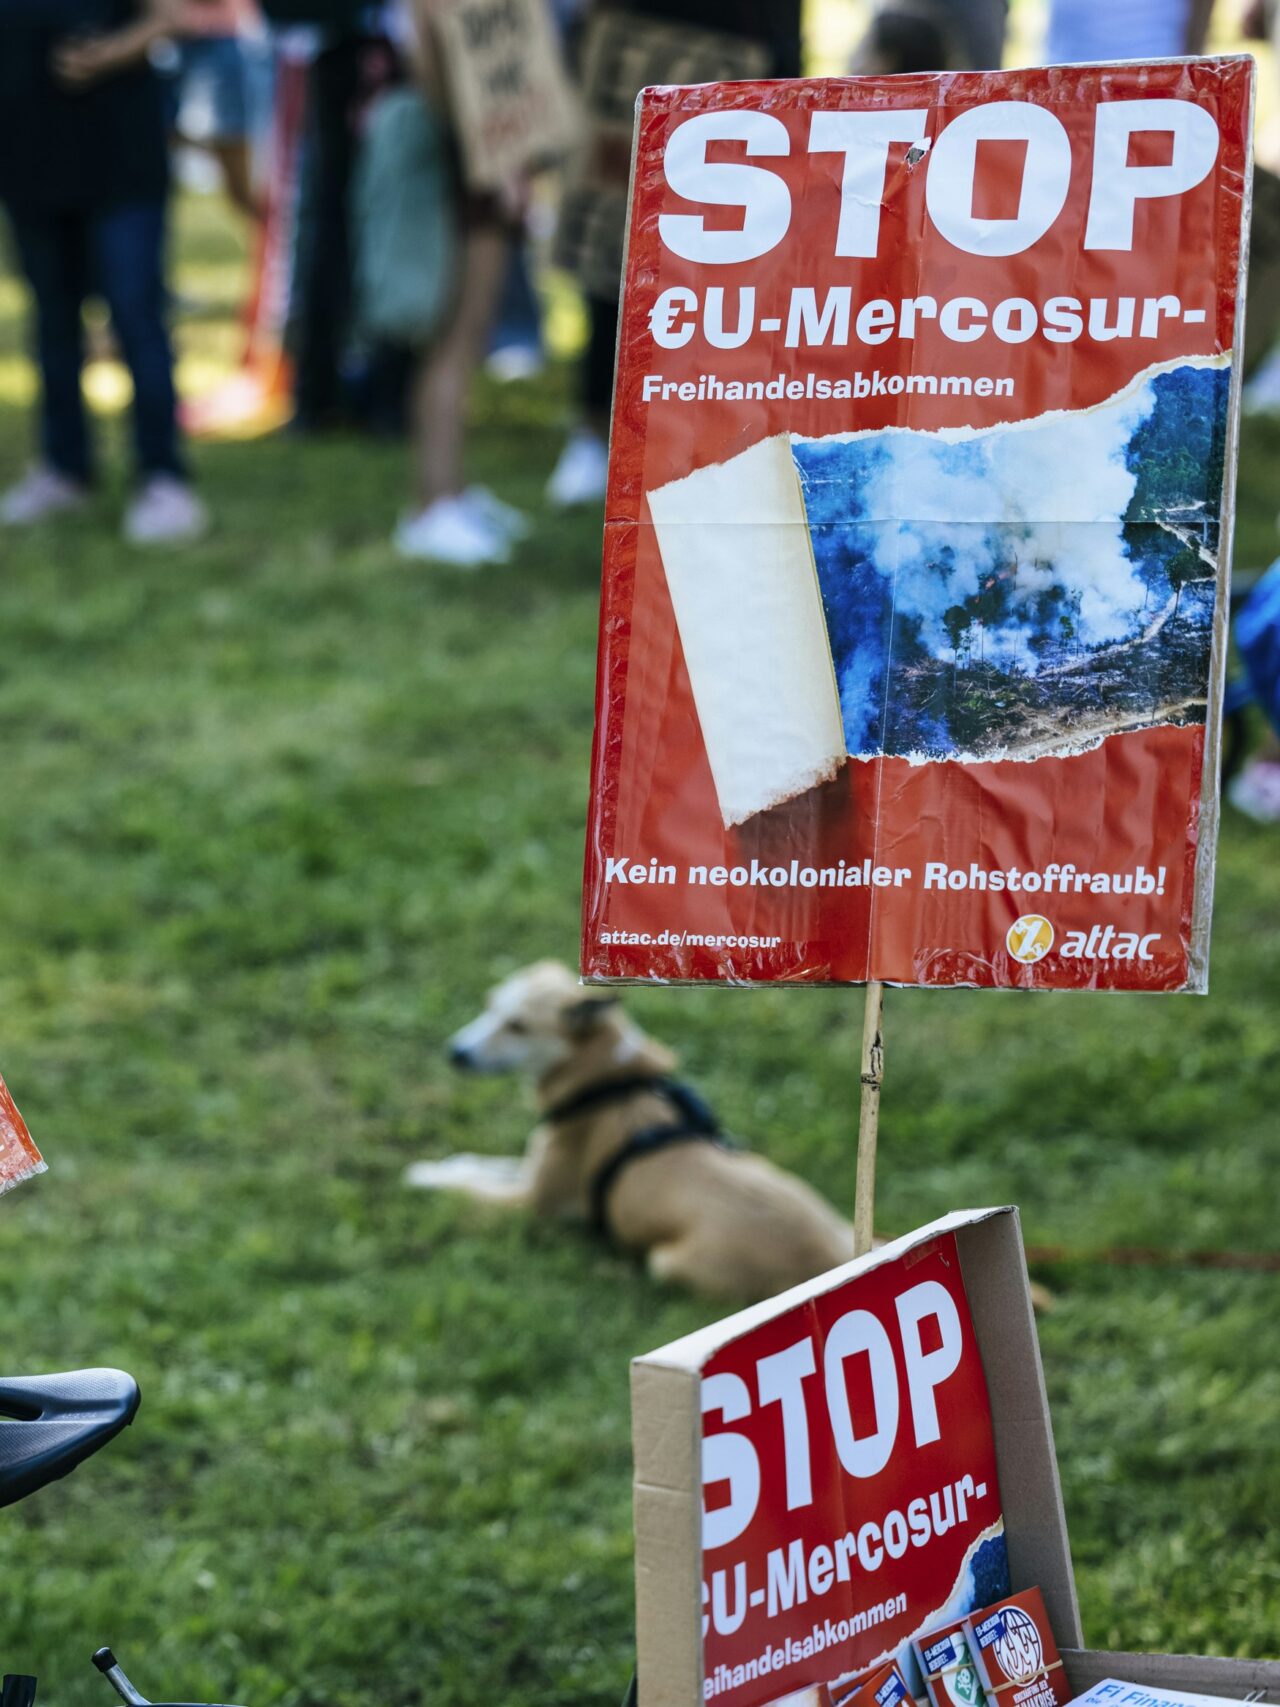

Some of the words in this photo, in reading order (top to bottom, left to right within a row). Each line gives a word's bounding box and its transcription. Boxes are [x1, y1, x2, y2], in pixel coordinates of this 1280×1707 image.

[657, 98, 1221, 264] STOP
[648, 286, 1206, 349] €U-Mercosur-
[641, 370, 1015, 402] Freihandelsabkommen
[604, 857, 676, 885] Kein
[688, 859, 912, 888] neokolonialer
[923, 862, 1166, 896] Rohstoffraub!
[600, 929, 781, 949] attac.de/mercosur
[1059, 924, 1161, 961] attac
[701, 1280, 963, 1551] STOP
[703, 1592, 907, 1700] eihandelsabkommen
